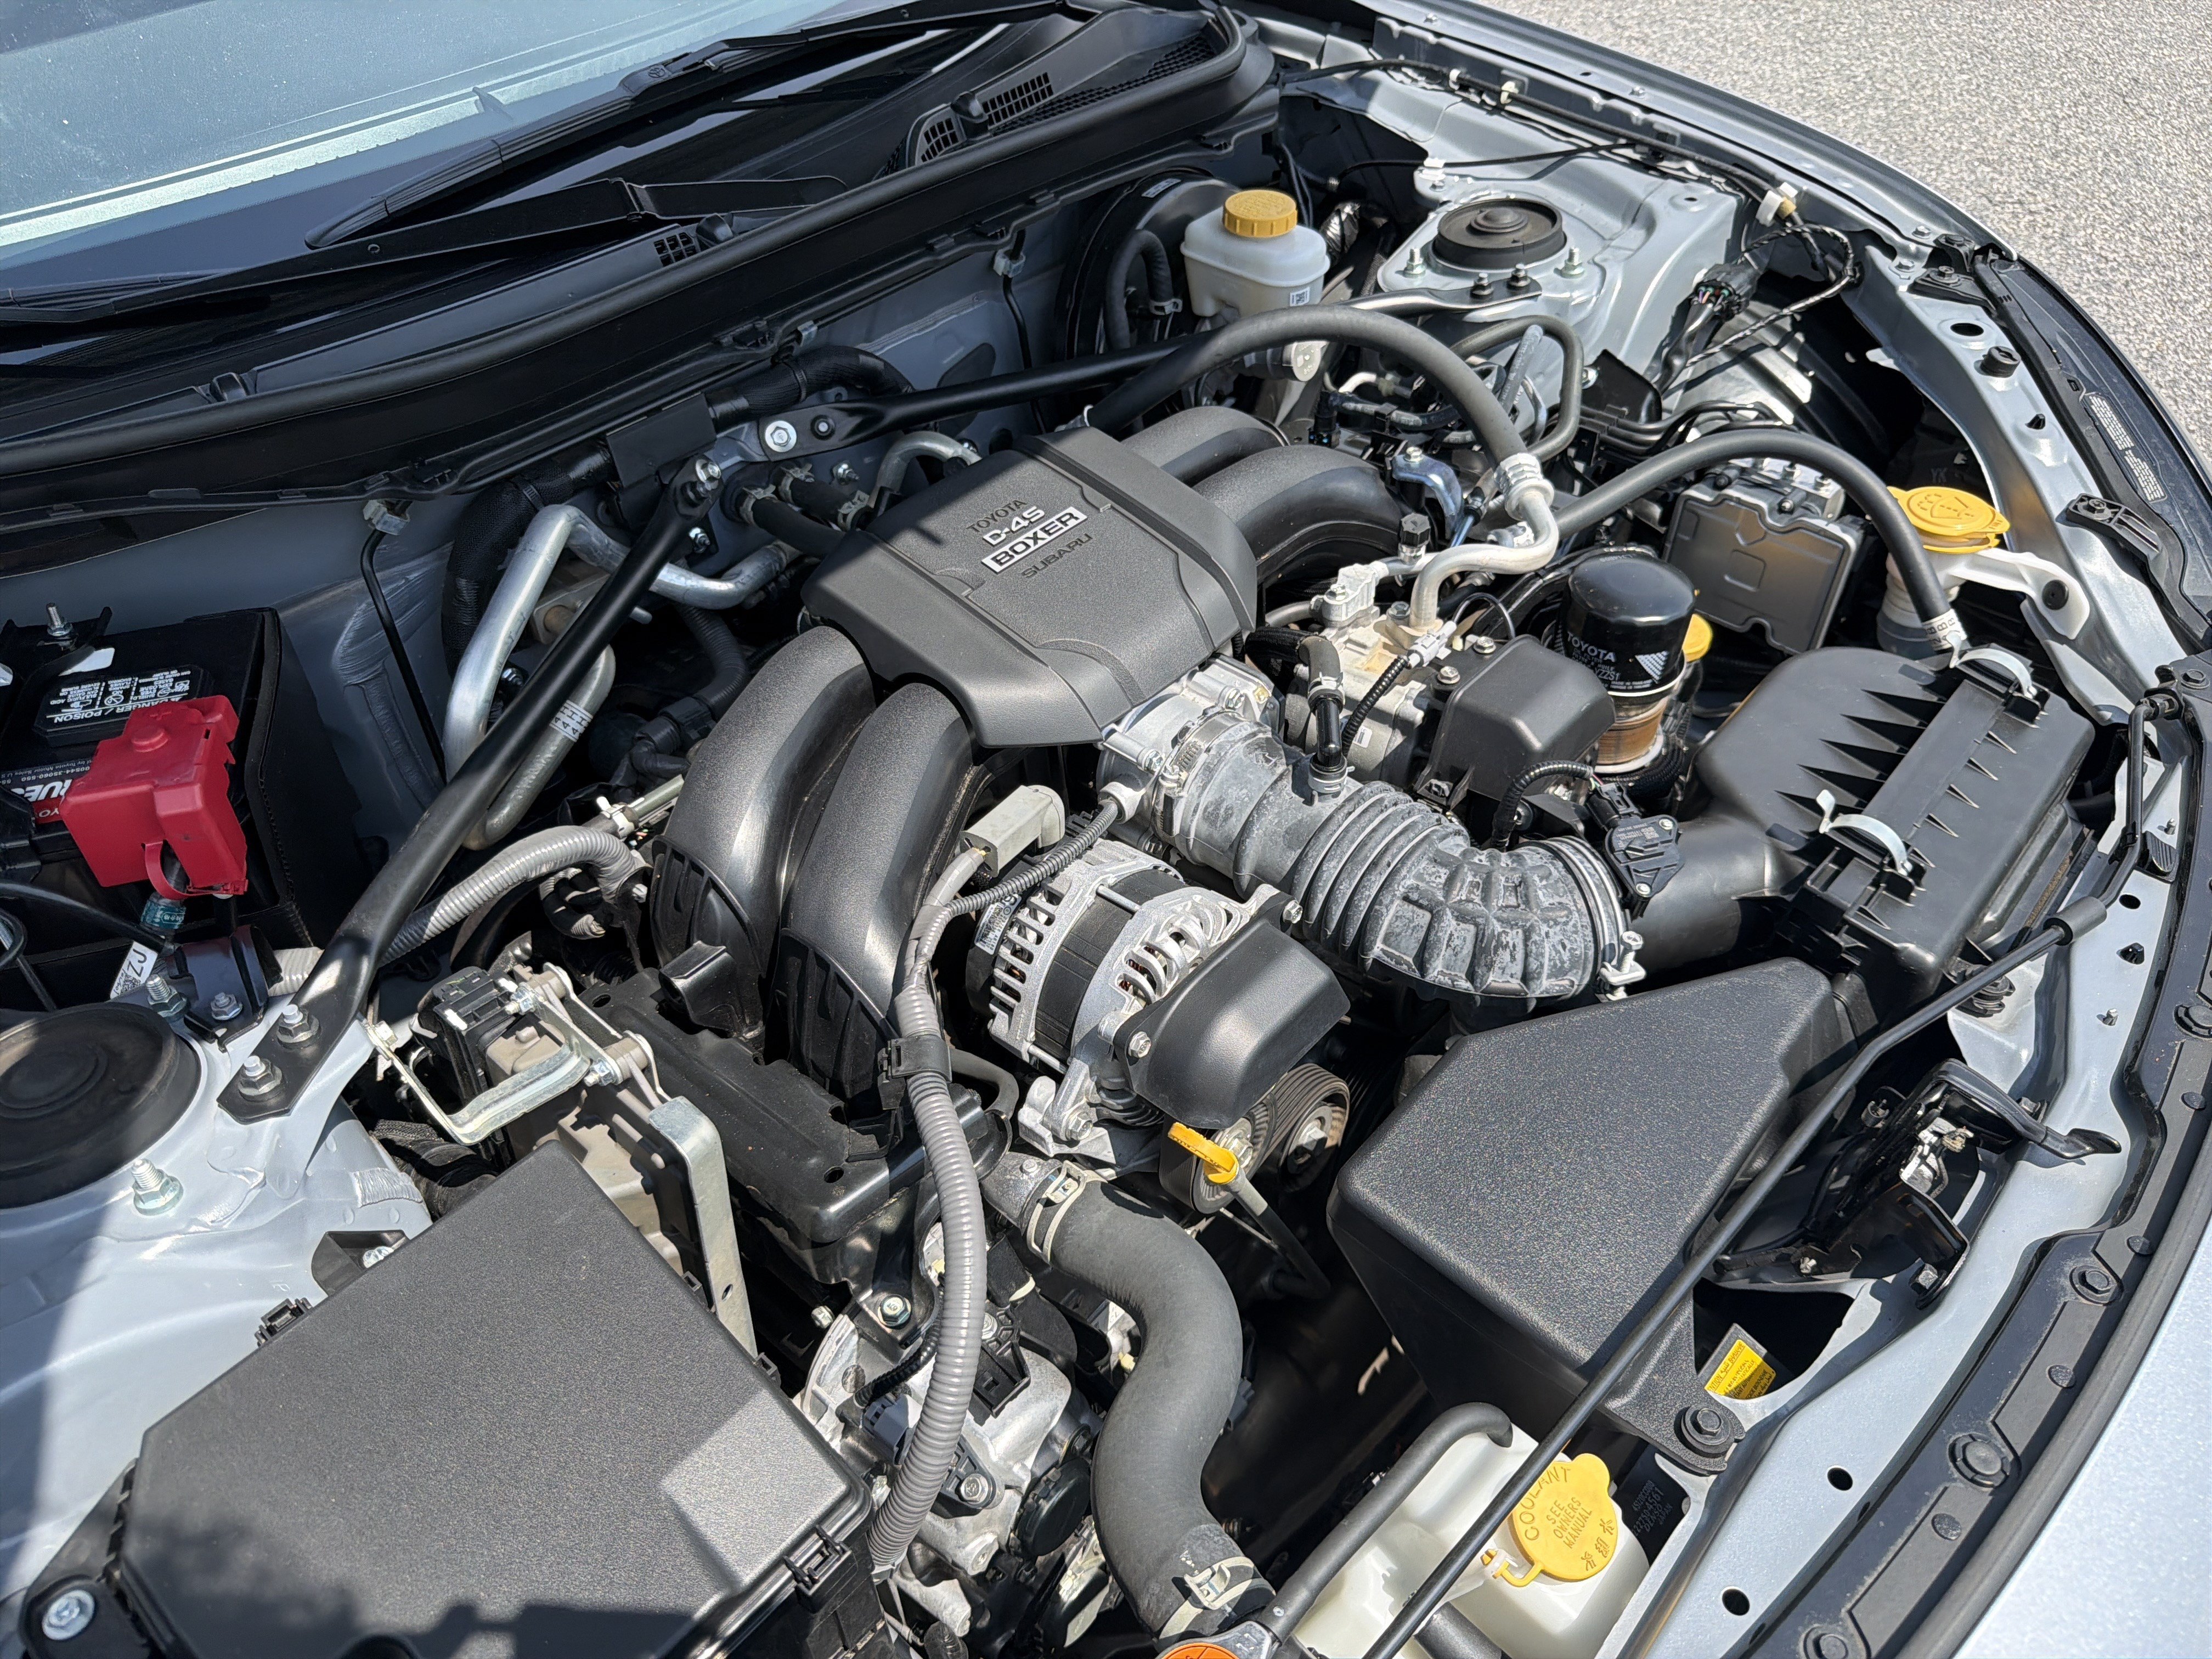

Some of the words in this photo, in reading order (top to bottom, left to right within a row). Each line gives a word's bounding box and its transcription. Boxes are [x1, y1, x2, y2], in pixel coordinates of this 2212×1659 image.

[966, 500, 1028, 533] TOYOTA
[983, 506, 1045, 547] D-4S
[990, 512, 1080, 567] BOXER
[1022, 533, 1093, 578] SUBARU
[1567, 631, 1615, 662] TOYOTA
[53, 709, 102, 723] POISON
[66, 693, 97, 702] SULFURIC
[127, 948, 147, 978] ZJ
[1519, 1466, 1571, 1541] COOLANT
[1546, 1499, 1565, 1525] SEE
[1554, 1497, 1582, 1539] OWNERS
[1562, 1507, 1593, 1549] MANUAL
